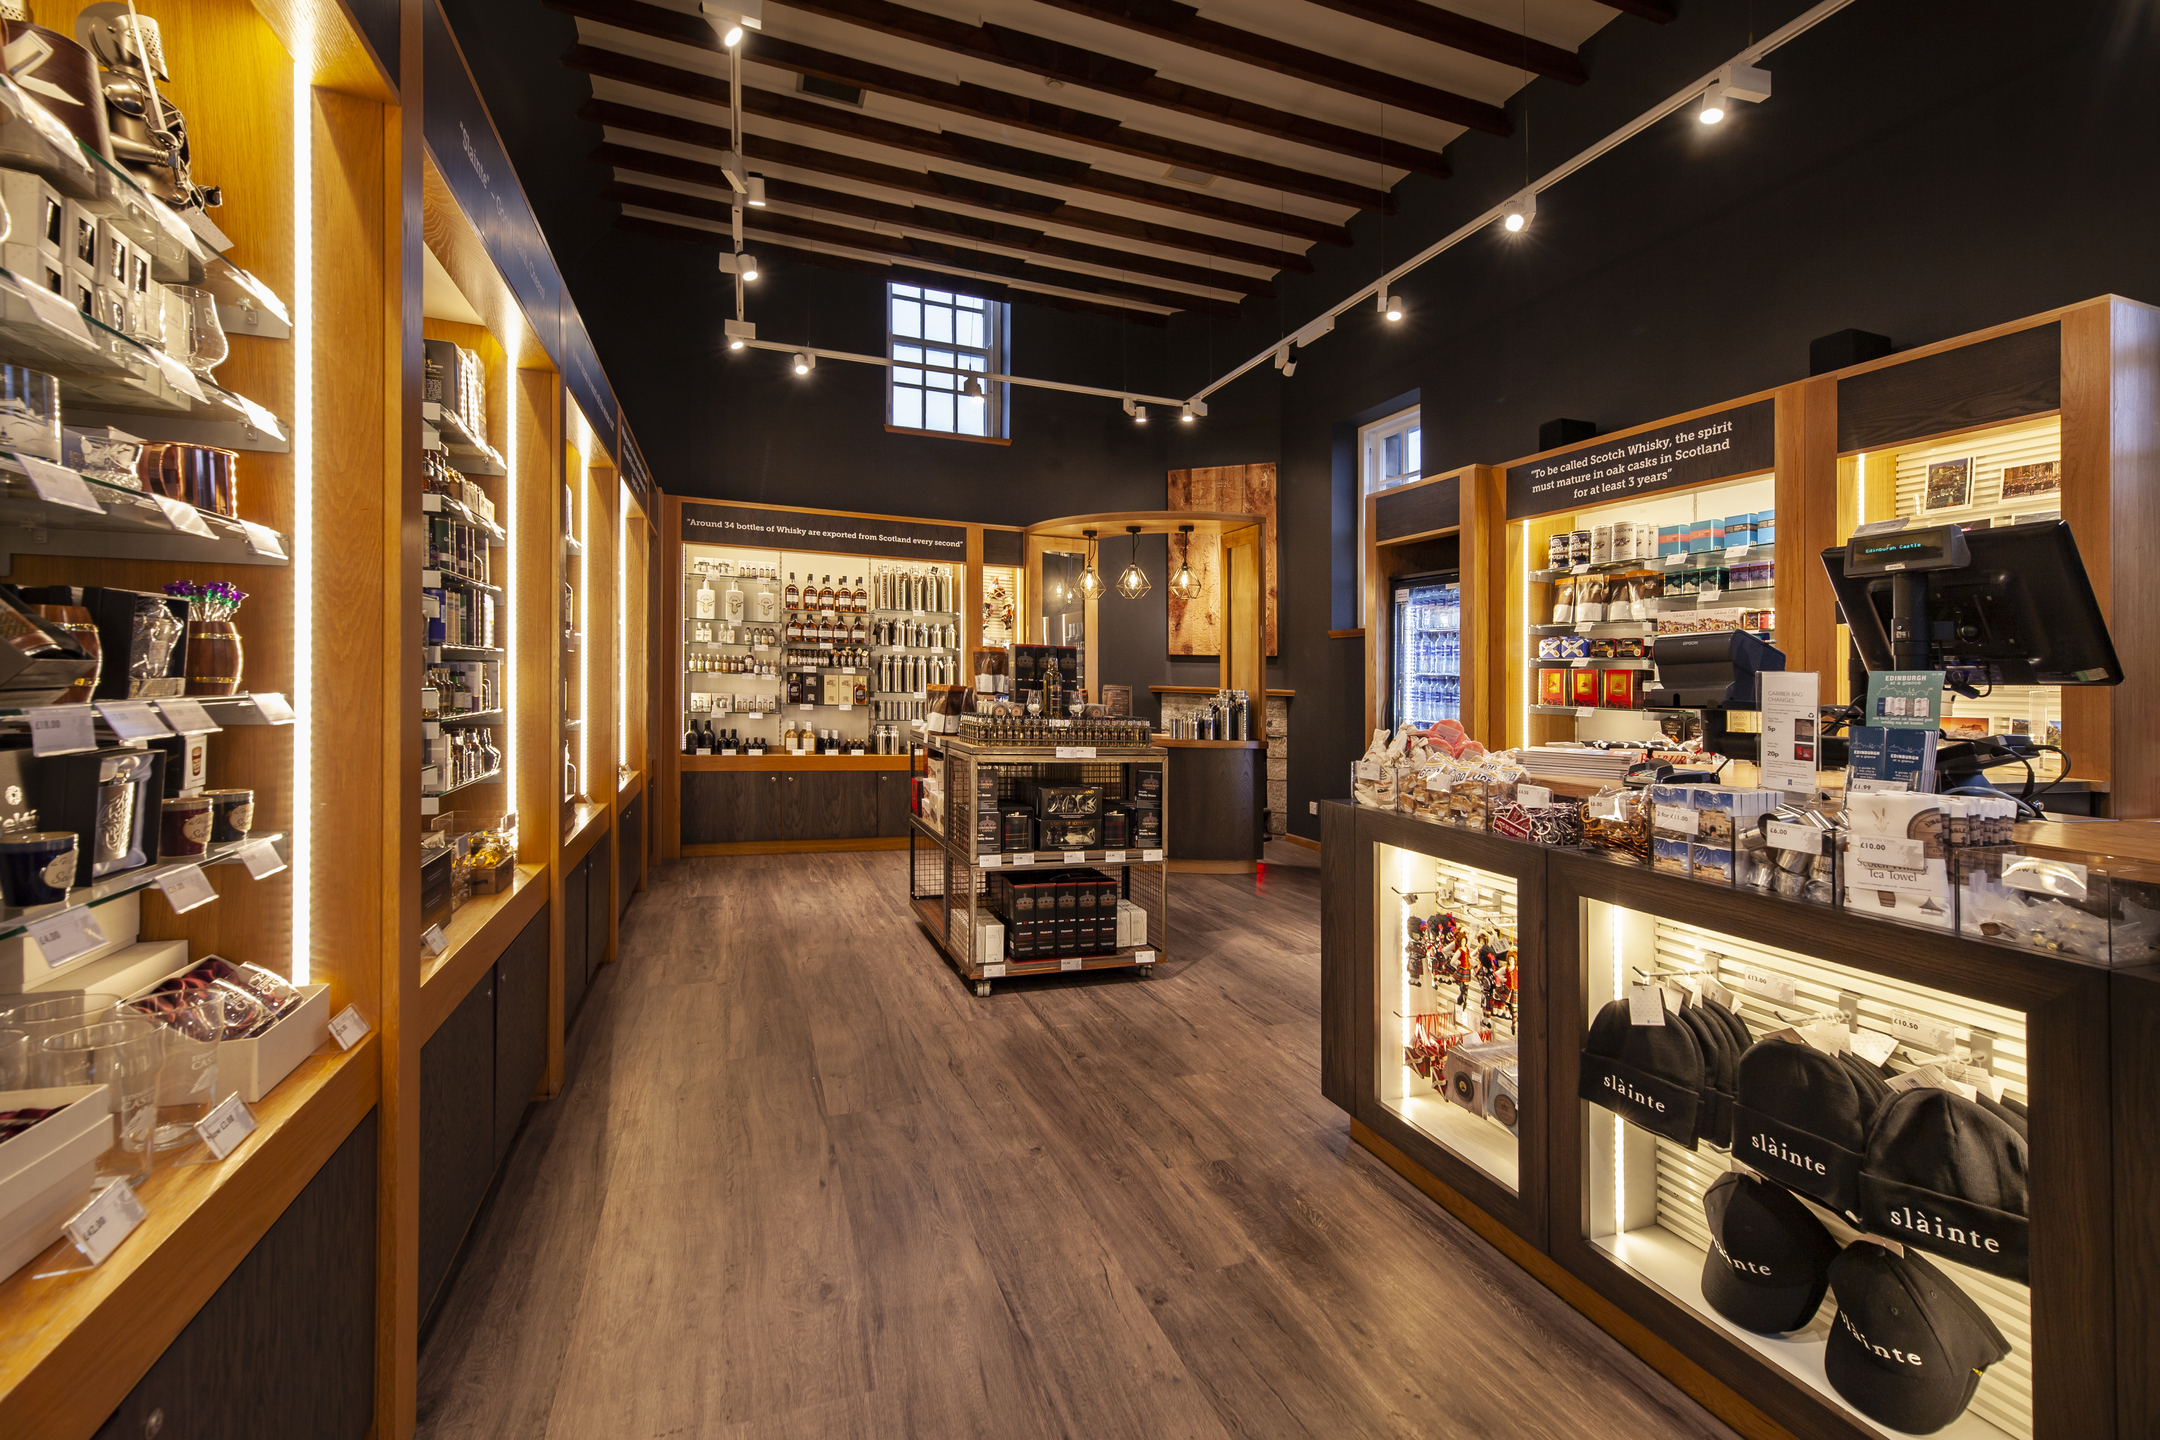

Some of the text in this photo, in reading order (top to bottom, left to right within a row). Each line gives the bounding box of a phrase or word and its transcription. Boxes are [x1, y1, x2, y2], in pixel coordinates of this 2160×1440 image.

[1547, 466, 1558, 475] be
[1560, 457, 1588, 472] called
[1590, 448, 1625, 465] Scotch
[1627, 438, 1672, 456] Whisky,
[1675, 432, 1695, 444] the
[1697, 421, 1733, 440] spirit
[1532, 438, 1730, 493] must mature in oak casks in Scotland
[1573, 467, 1673, 499] for at least 3 years"
[724, 521, 735, 529] 34
[736, 522, 765, 532] bottles
[776, 526, 807, 536] Whisky
[822, 530, 857, 539] exported
[858, 532, 878, 541] from
[878, 534, 911, 543] Scotland
[912, 537, 933, 546] every
[1899, 542, 1922, 550] Castle
[1670, 813, 1689, 822] £11.00
[1770, 827, 1788, 836] £6.00
[1860, 842, 1886, 850] £10.00
[1868, 868, 1884, 878] Tea
[1888, 870, 1917, 882] Towel
[39, 930, 61, 945] £4.00
[1747, 974, 1767, 985] £13.00
[1893, 1018, 1919, 1030] £10.50
[1603, 1074, 1666, 1113] slàinte
[1751, 1133, 1826, 1176] slàinte
[1890, 1207, 2000, 1253] slàinte
